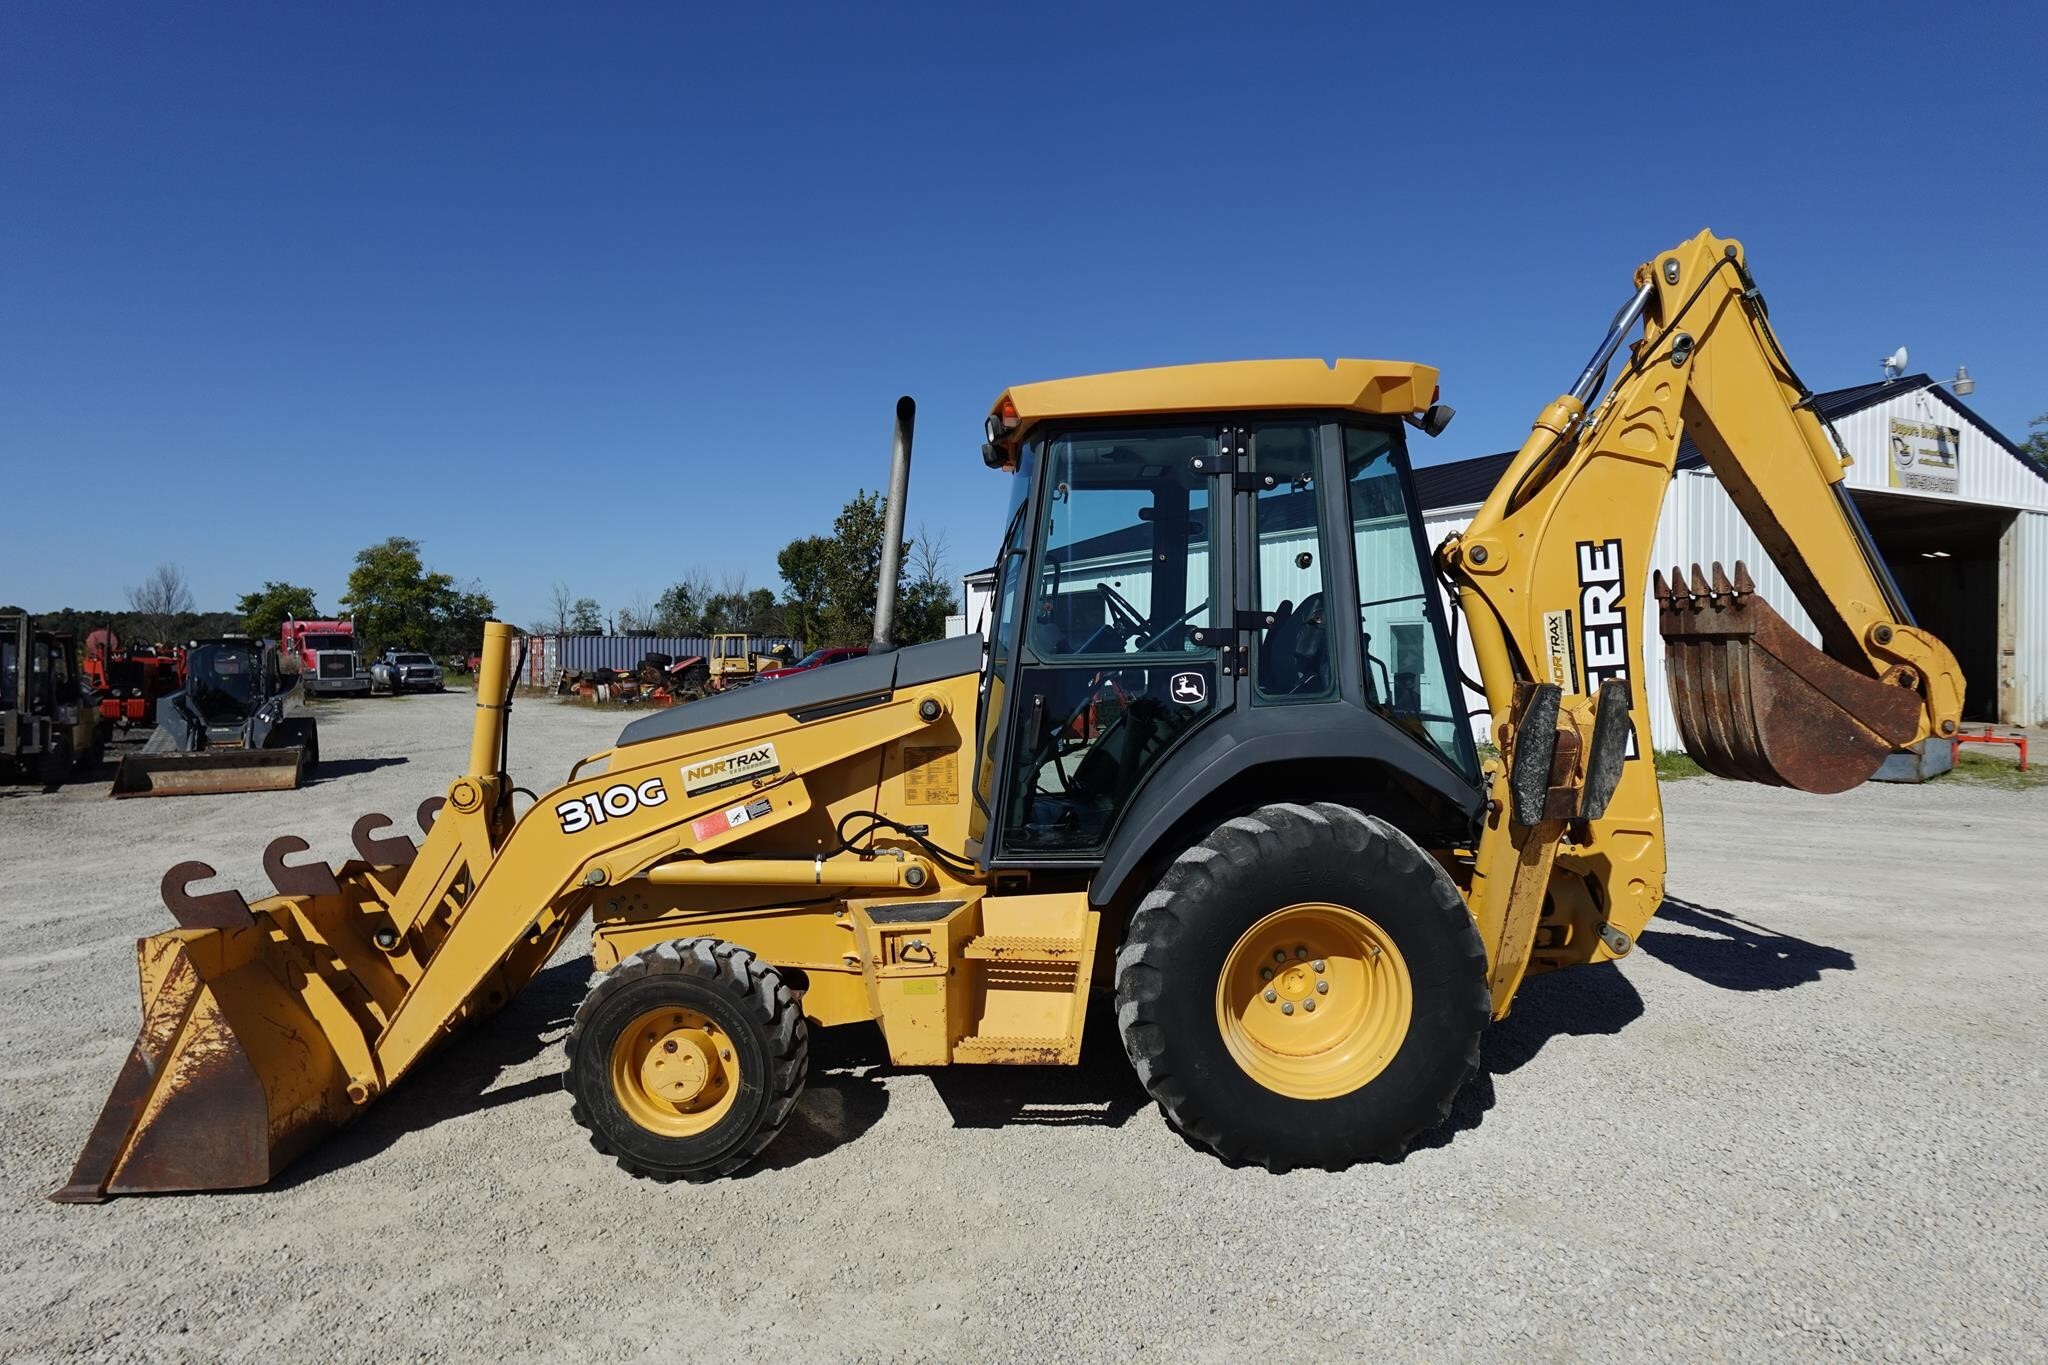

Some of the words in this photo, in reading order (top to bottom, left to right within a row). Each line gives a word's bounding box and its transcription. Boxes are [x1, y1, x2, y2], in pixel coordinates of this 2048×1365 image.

[1576, 541, 1640, 759] ERE
[687, 748, 770, 782] NORTRAX
[555, 777, 669, 834] 310G
